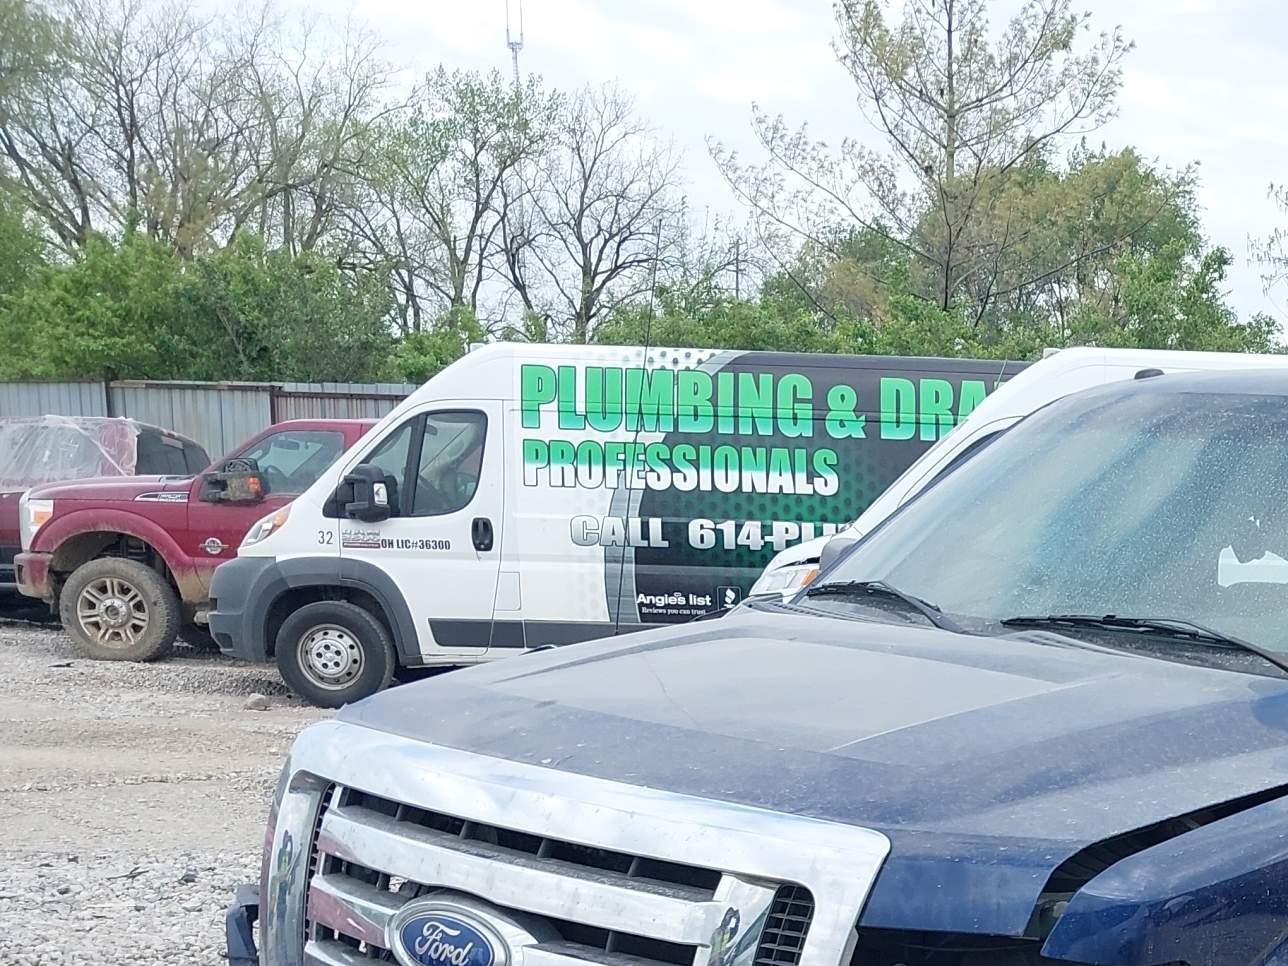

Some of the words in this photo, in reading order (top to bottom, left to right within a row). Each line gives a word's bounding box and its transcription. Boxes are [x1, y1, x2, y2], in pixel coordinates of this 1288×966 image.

[521, 364, 814, 438] PLUMBING
[825, 384, 868, 439] &
[880, 377, 1006, 441] DRA
[523, 439, 839, 496] PROFESSIONALS
[318, 530, 333, 545] 32
[570, 514, 669, 548] CALL
[381, 539, 394, 549] OH
[396, 539, 451, 550] LIC#36300
[641, 607, 667, 615] Reviews
[667, 608, 679, 616] you
[689, 593, 711, 606] list
[415, 921, 474, 966] Ford
